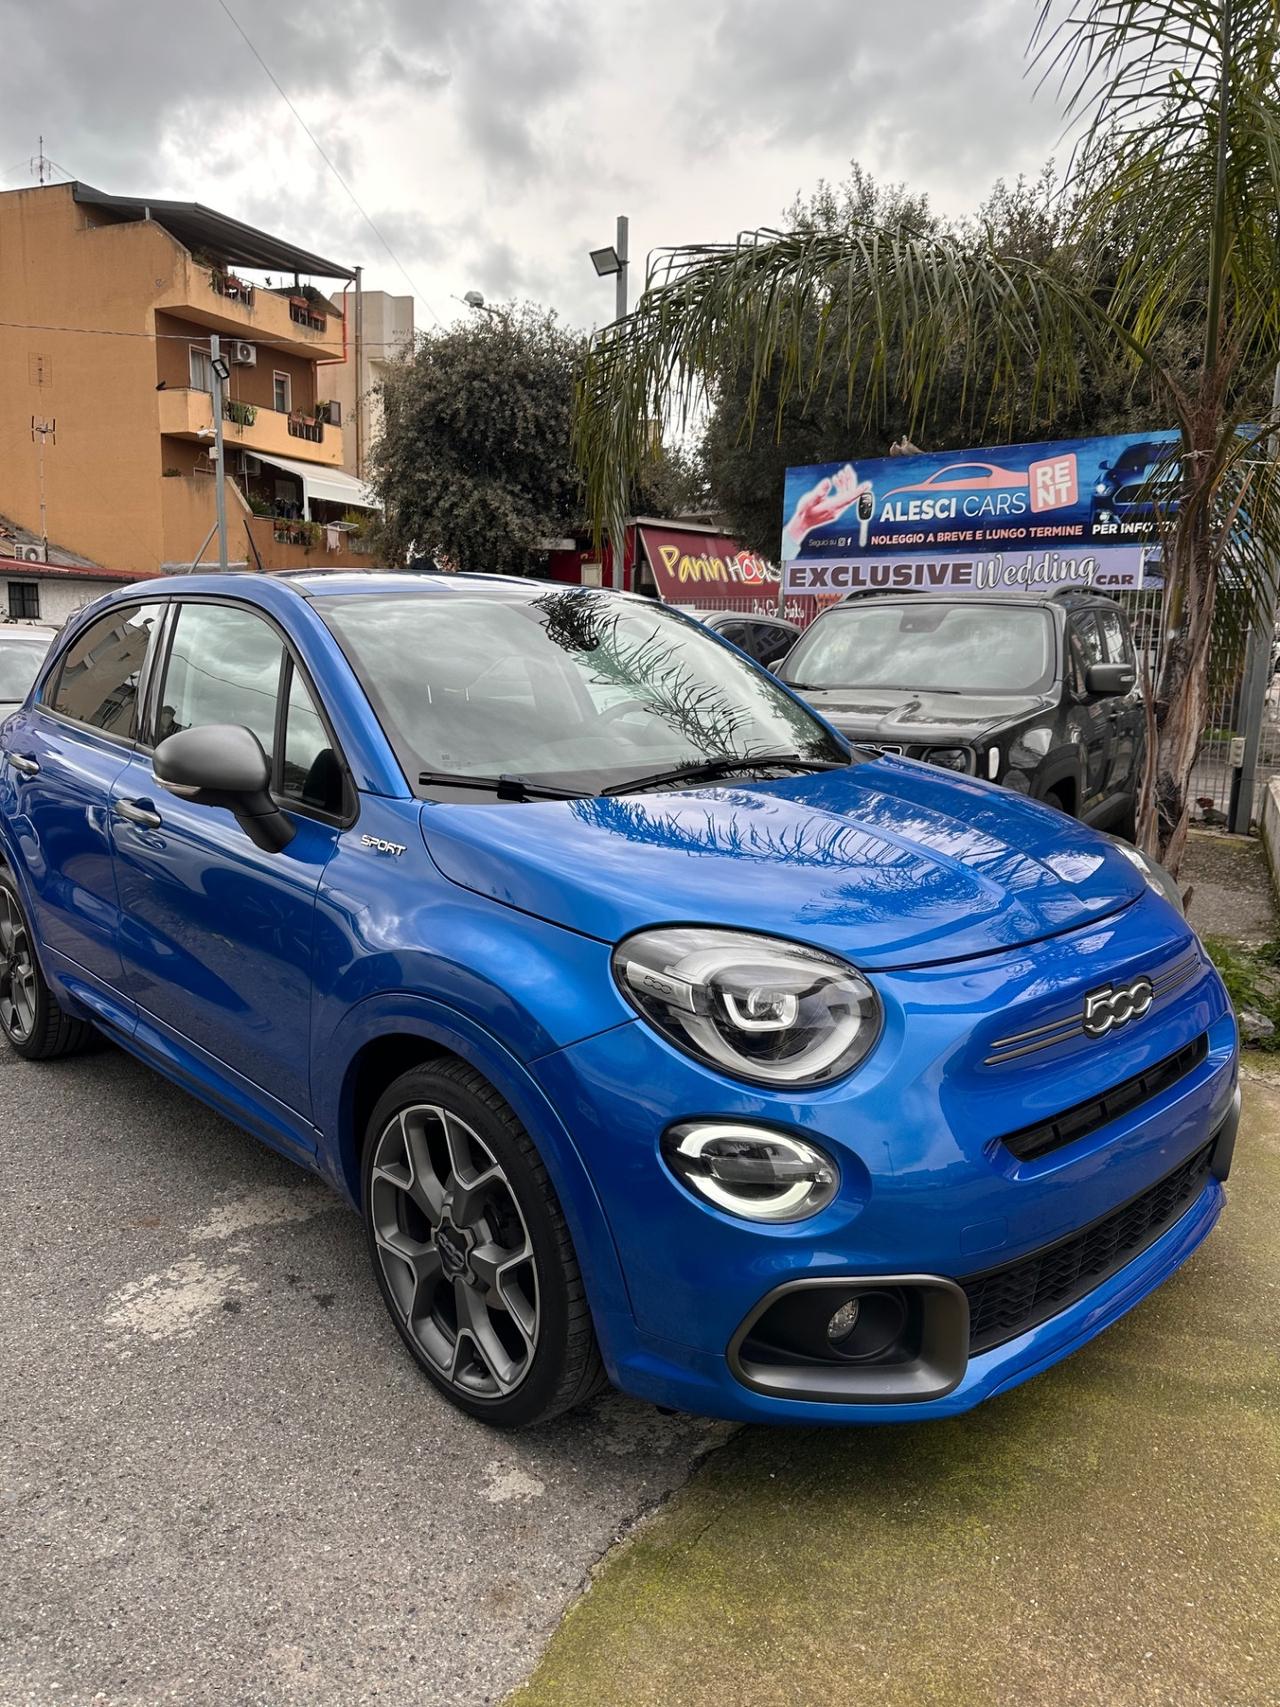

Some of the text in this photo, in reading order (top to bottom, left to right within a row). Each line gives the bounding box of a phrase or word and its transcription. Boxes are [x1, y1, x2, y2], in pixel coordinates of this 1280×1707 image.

[879, 492, 1026, 523] ALESCI CARS
[871, 525, 1083, 546] NOLEGGIO A BREVE E LUNGO TERMINE
[1092, 523, 1117, 535] PER
[788, 552, 1134, 588] EXCLUSIVE Wedding CAR
[360, 834, 407, 856] SPORT
[643, 975, 673, 995] 500
[1084, 979, 1153, 1035] 500
